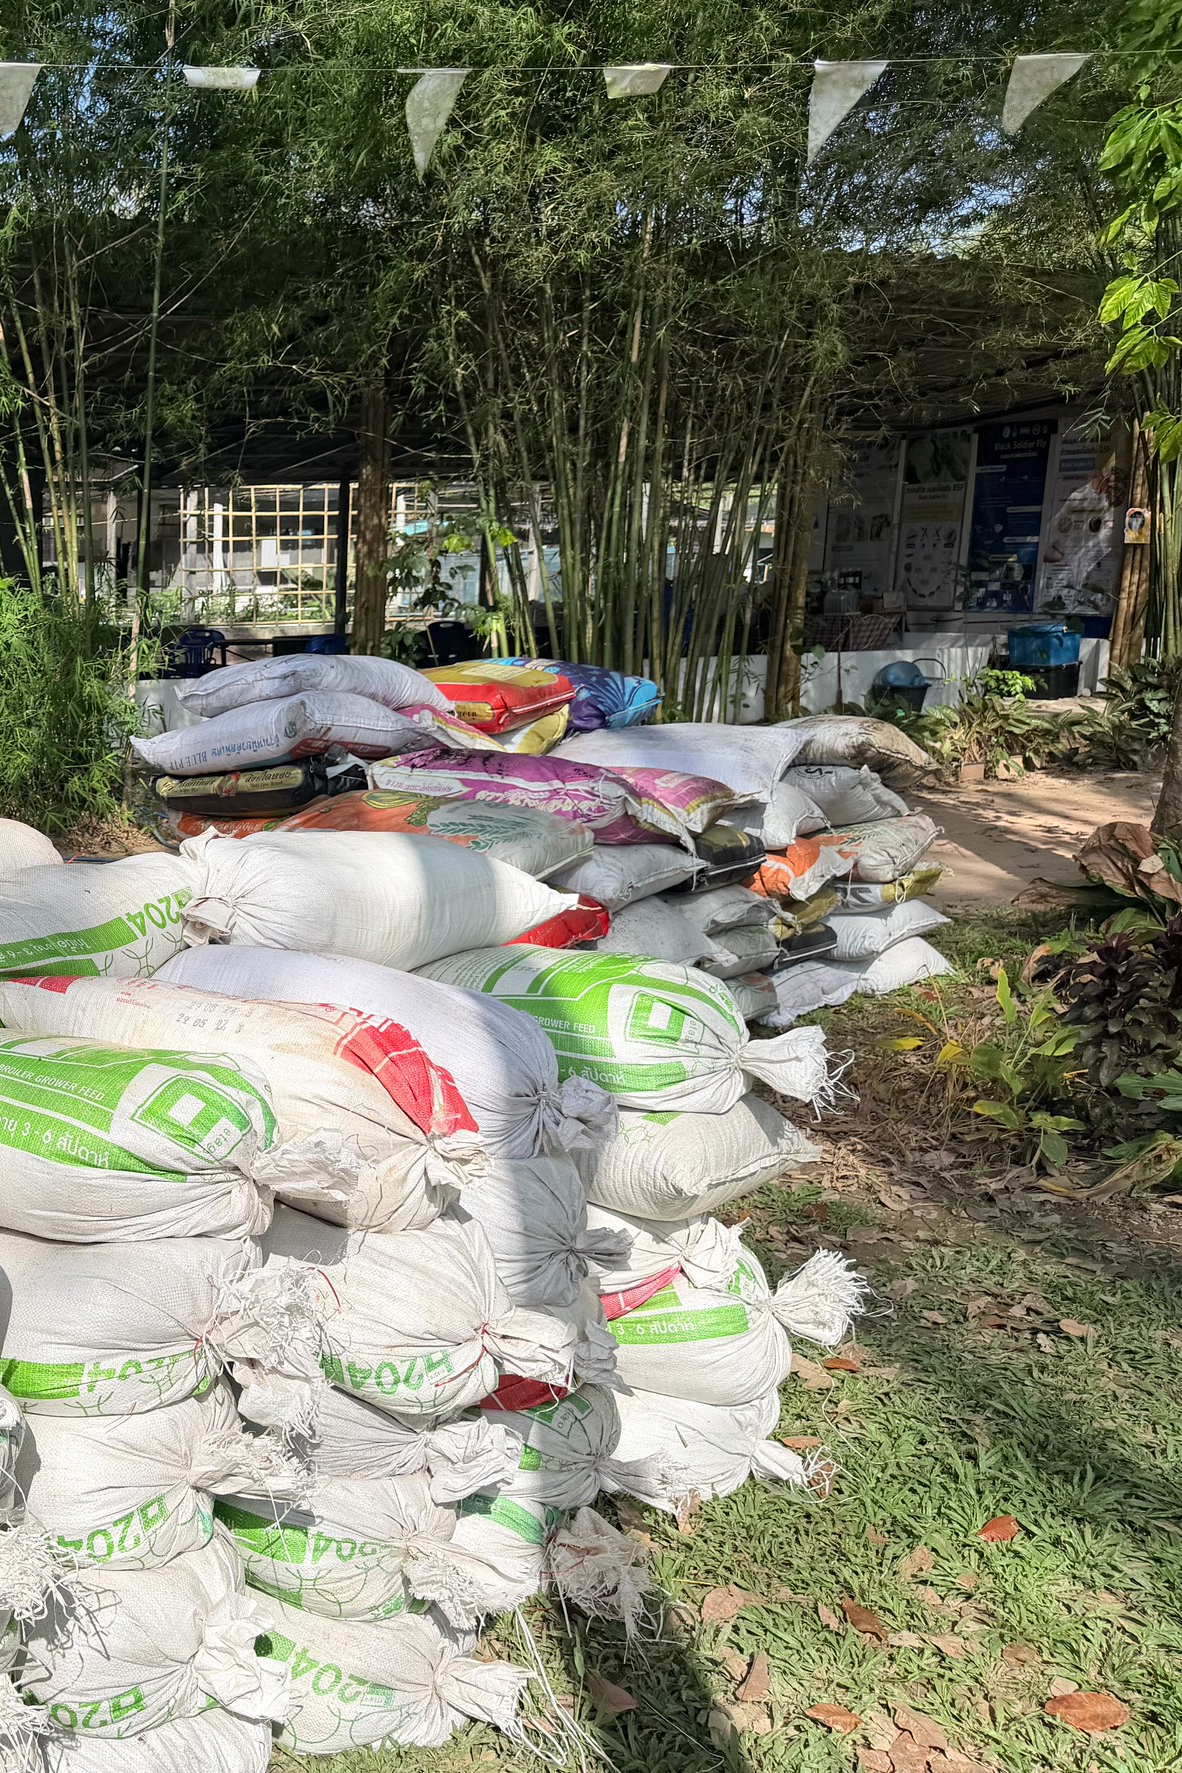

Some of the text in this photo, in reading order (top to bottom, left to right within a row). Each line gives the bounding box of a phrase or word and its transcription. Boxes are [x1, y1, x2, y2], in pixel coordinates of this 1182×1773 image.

[187, 751, 208, 768] BLUE
[573, 1022, 595, 1034] FEED
[35, 1072, 78, 1091] GROWER
[78, 1086, 105, 1101] FEED
[22, 1121, 31, 1135] 3
[42, 1128, 52, 1143] 6
[56, 1132, 110, 1168] สัปดาห์
[617, 1323, 625, 1335] 3
[636, 1323, 645, 1335] 6
[348, 1360, 426, 1395] 204
[290, 1645, 378, 1705] 204
[50, 1701, 111, 1730] 20
